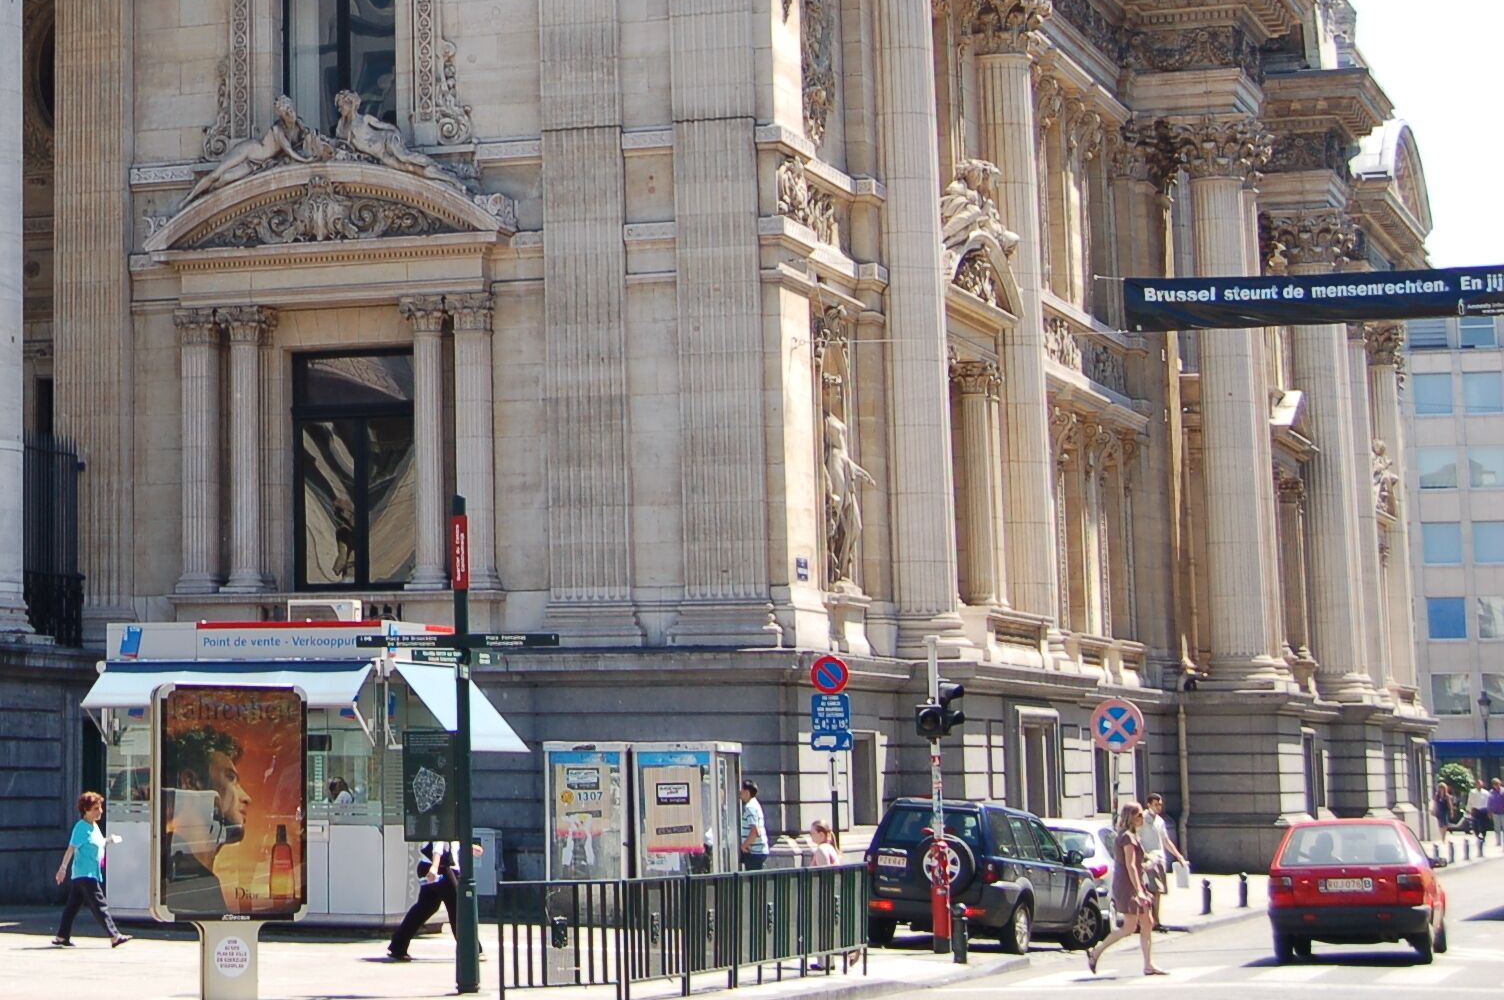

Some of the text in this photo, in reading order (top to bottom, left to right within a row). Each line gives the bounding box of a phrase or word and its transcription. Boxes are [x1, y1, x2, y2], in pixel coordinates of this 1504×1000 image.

[1144, 287, 1216, 302] Brussel
[1224, 285, 1278, 301] steunt
[1283, 284, 1304, 299] de
[1311, 279, 1450, 298] mensenrechten.
[1460, 276, 1482, 290] En
[203, 637, 230, 647] Point
[235, 637, 247, 647] de
[251, 638, 281, 647] vente
[577, 791, 603, 801] 1307
[235, 887, 259, 899] Dior
